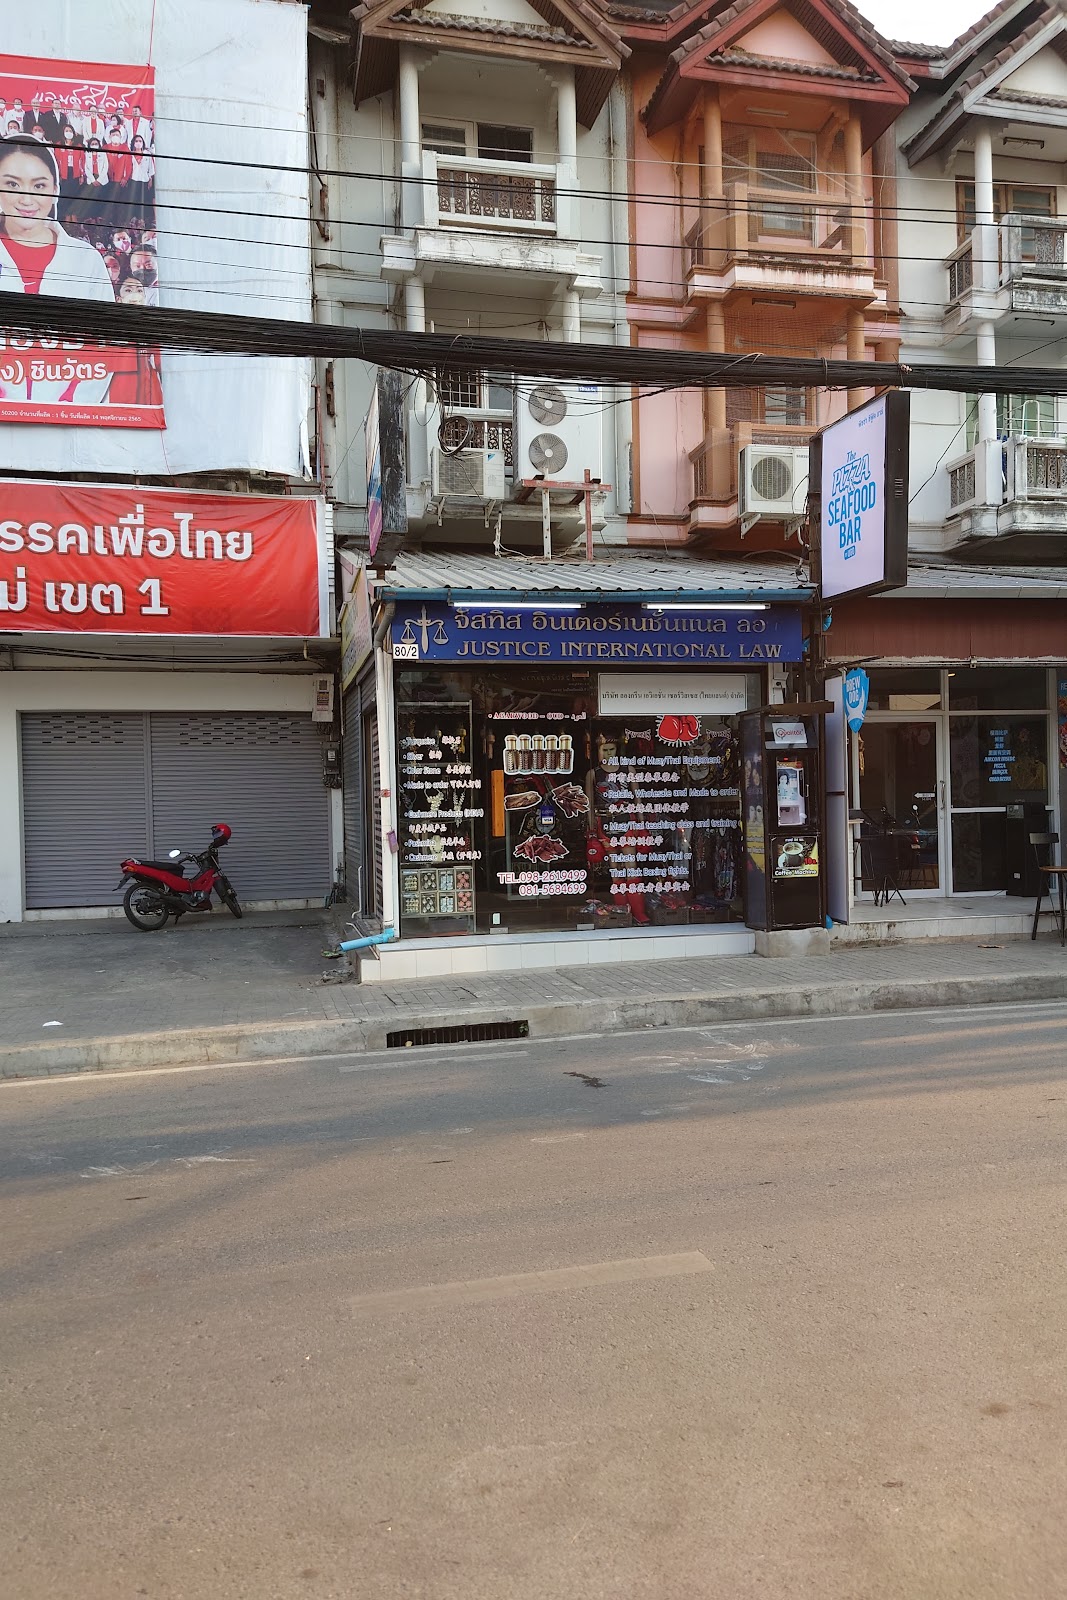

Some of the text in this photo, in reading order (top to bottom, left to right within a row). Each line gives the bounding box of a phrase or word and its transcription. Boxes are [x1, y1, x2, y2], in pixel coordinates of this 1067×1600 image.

[31, 358, 107, 380] ชินวัตร
[847, 450, 856, 462] The
[832, 454, 871, 497] PIZZA
[828, 482, 876, 526] SEAFOOD
[840, 516, 861, 548] BAR
[45, 579, 124, 614] เขต
[138, 578, 169, 615] 1
[394, 646, 418, 658] 80/2
[456, 640, 782, 658] JUSTICE INTERNATIONAL LAW
[602, 690, 618, 699] บริษัท
[608, 756, 619, 766] All
[620, 756, 636, 765] kind
[637, 756, 646, 765] of
[682, 755, 721, 766] Equipment
[433, 780, 449, 788] order
[635, 788, 672, 798] Wholesale
[673, 788, 687, 797] and
[689, 788, 709, 797] Made
[710, 788, 718, 796] to
[720, 787, 738, 796] order
[646, 820, 676, 830] teaching
[677, 819, 694, 829] class
[696, 819, 710, 828] and
[711, 818, 737, 829] training
[610, 853, 635, 862] Tickets
[636, 852, 647, 862] for
[497, 870, 587, 884] TEL.098-2619499
[609, 866, 689, 878] Thai Kick Boxing fights.
[519, 882, 587, 895] 081-5684699
